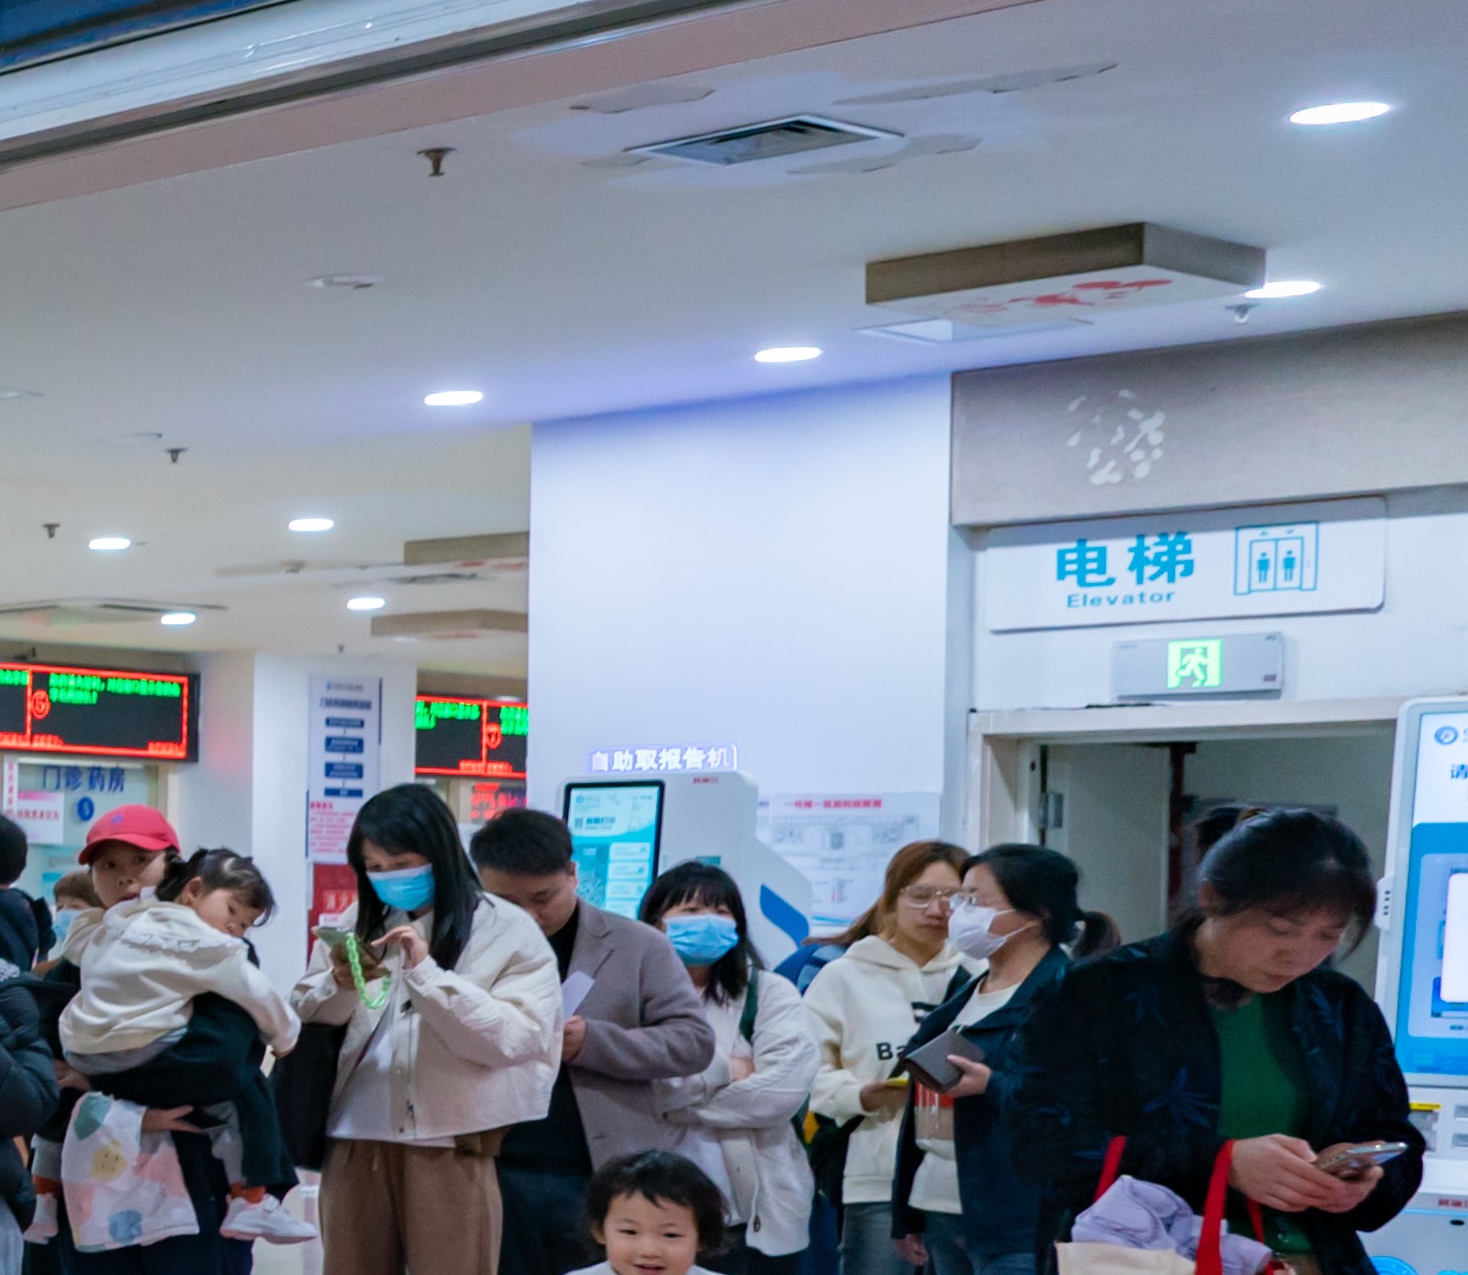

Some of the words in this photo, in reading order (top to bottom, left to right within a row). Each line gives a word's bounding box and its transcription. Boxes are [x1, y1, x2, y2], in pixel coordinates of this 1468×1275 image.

[1056, 530, 1195, 588] 电梯
[1066, 589, 1175, 608] Elevator
[592, 746, 730, 772] 自助取报告机
[43, 764, 125, 792] 门诊药房
